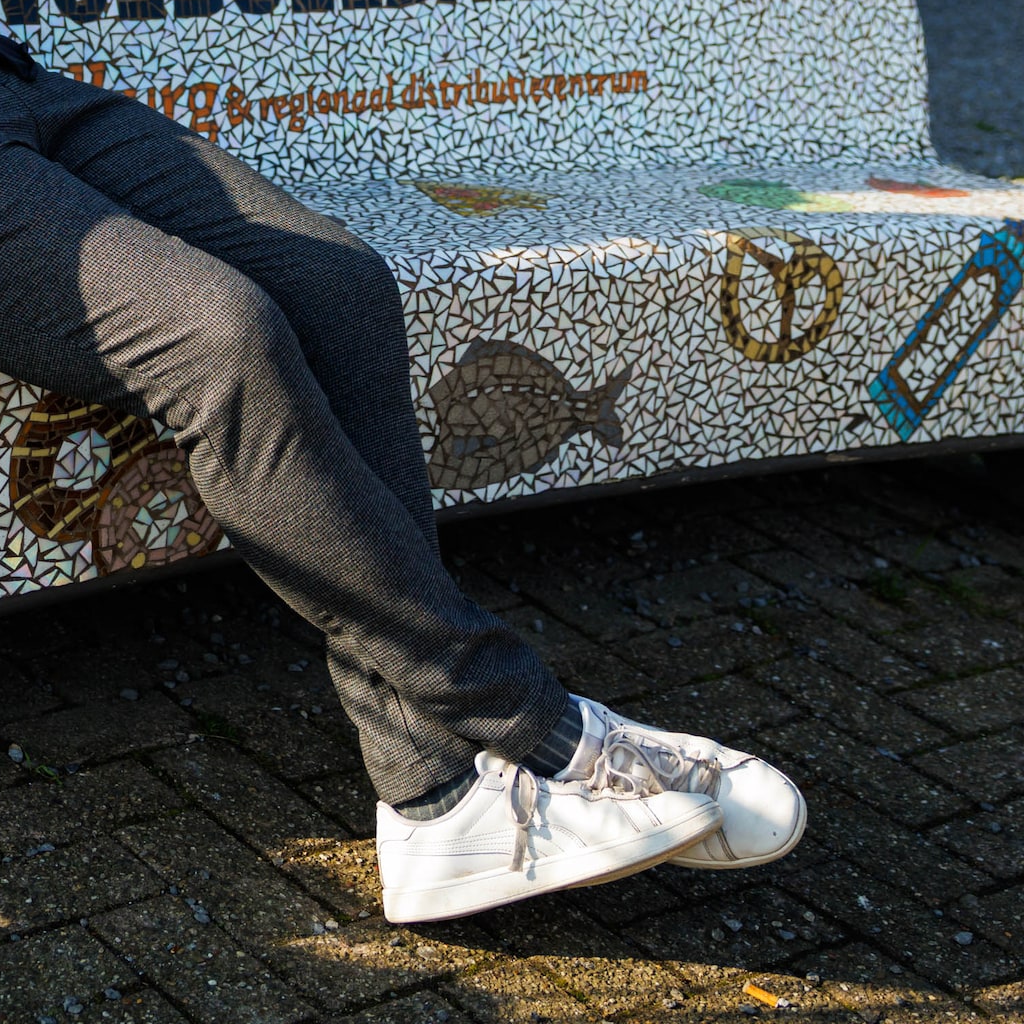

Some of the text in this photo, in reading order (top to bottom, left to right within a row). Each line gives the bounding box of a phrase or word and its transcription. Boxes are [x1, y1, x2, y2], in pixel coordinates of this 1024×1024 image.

[226, 83, 253, 126] &
[259, 74, 395, 133] regionaal
[401, 68, 648, 109] distributiecentrum
